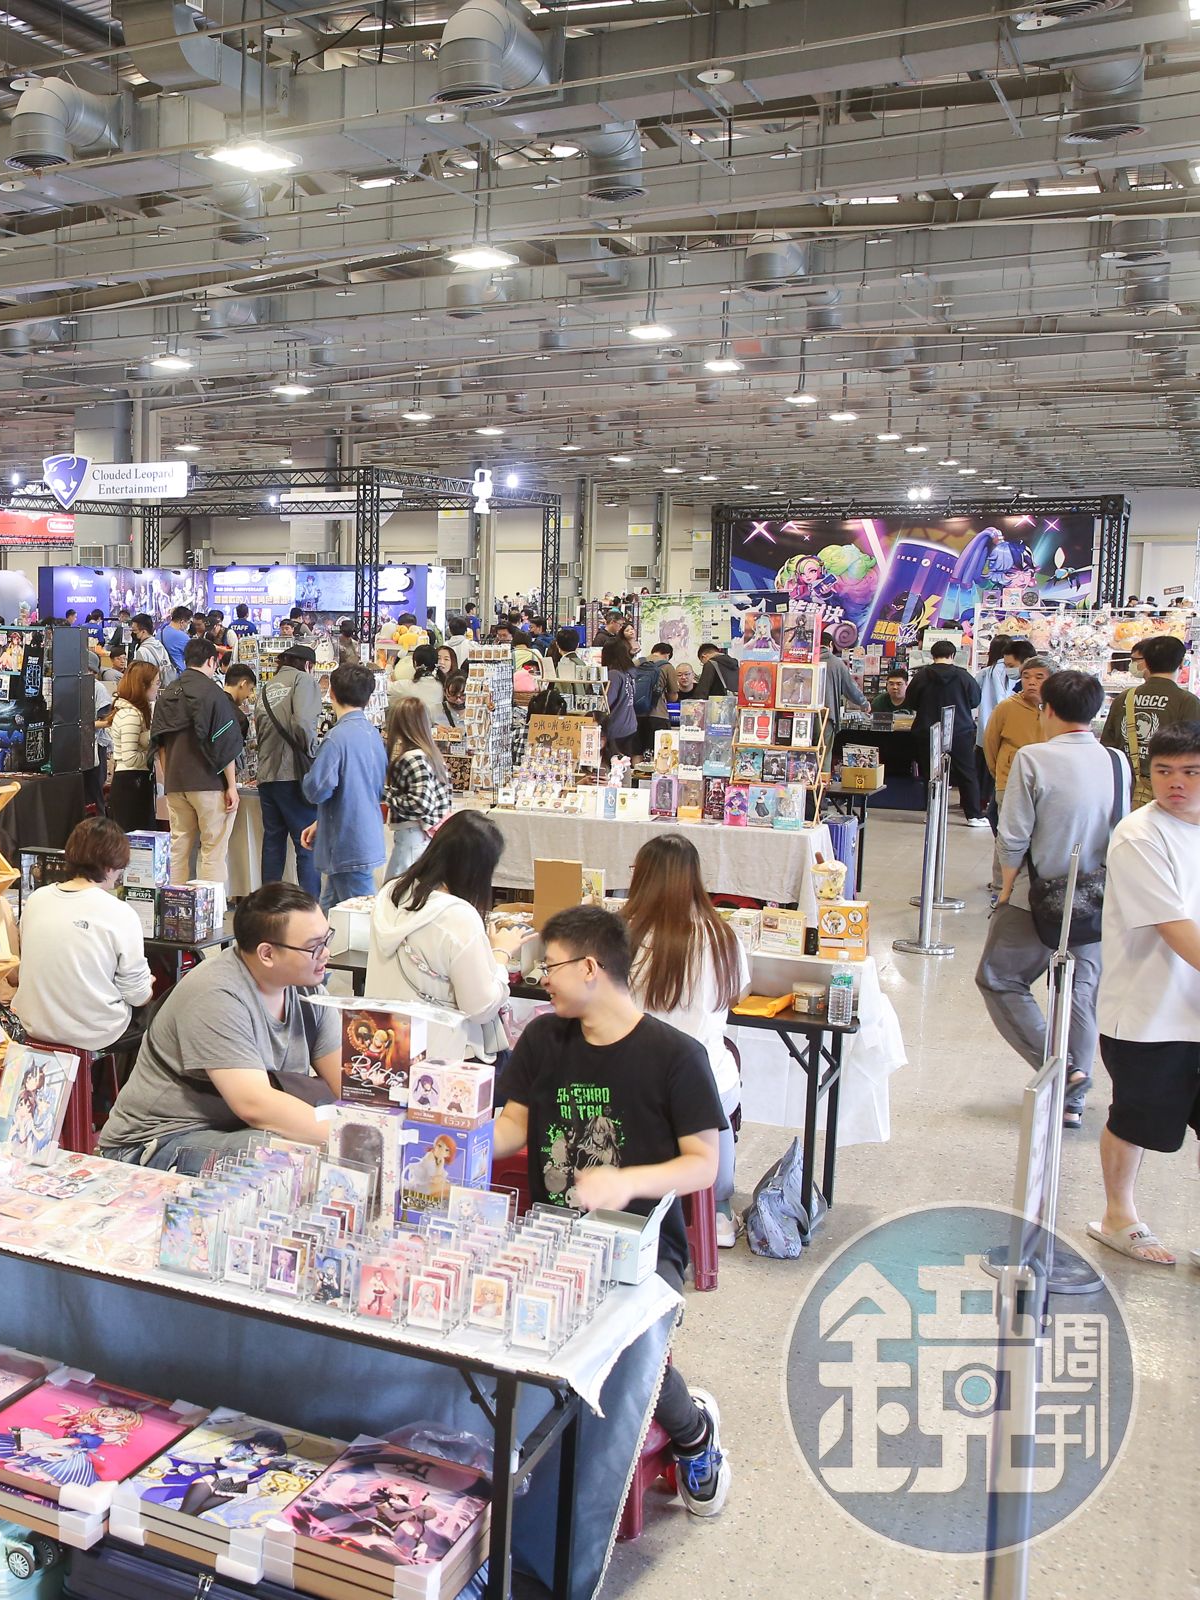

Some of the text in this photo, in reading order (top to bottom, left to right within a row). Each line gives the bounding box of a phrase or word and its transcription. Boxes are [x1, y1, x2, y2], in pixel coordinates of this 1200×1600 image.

[92, 467, 174, 482] Clouded Leopard
[98, 483, 168, 495] Entertainment
[230, 624, 249, 632] STAFF
[1125, 694, 1169, 708] NGCC
